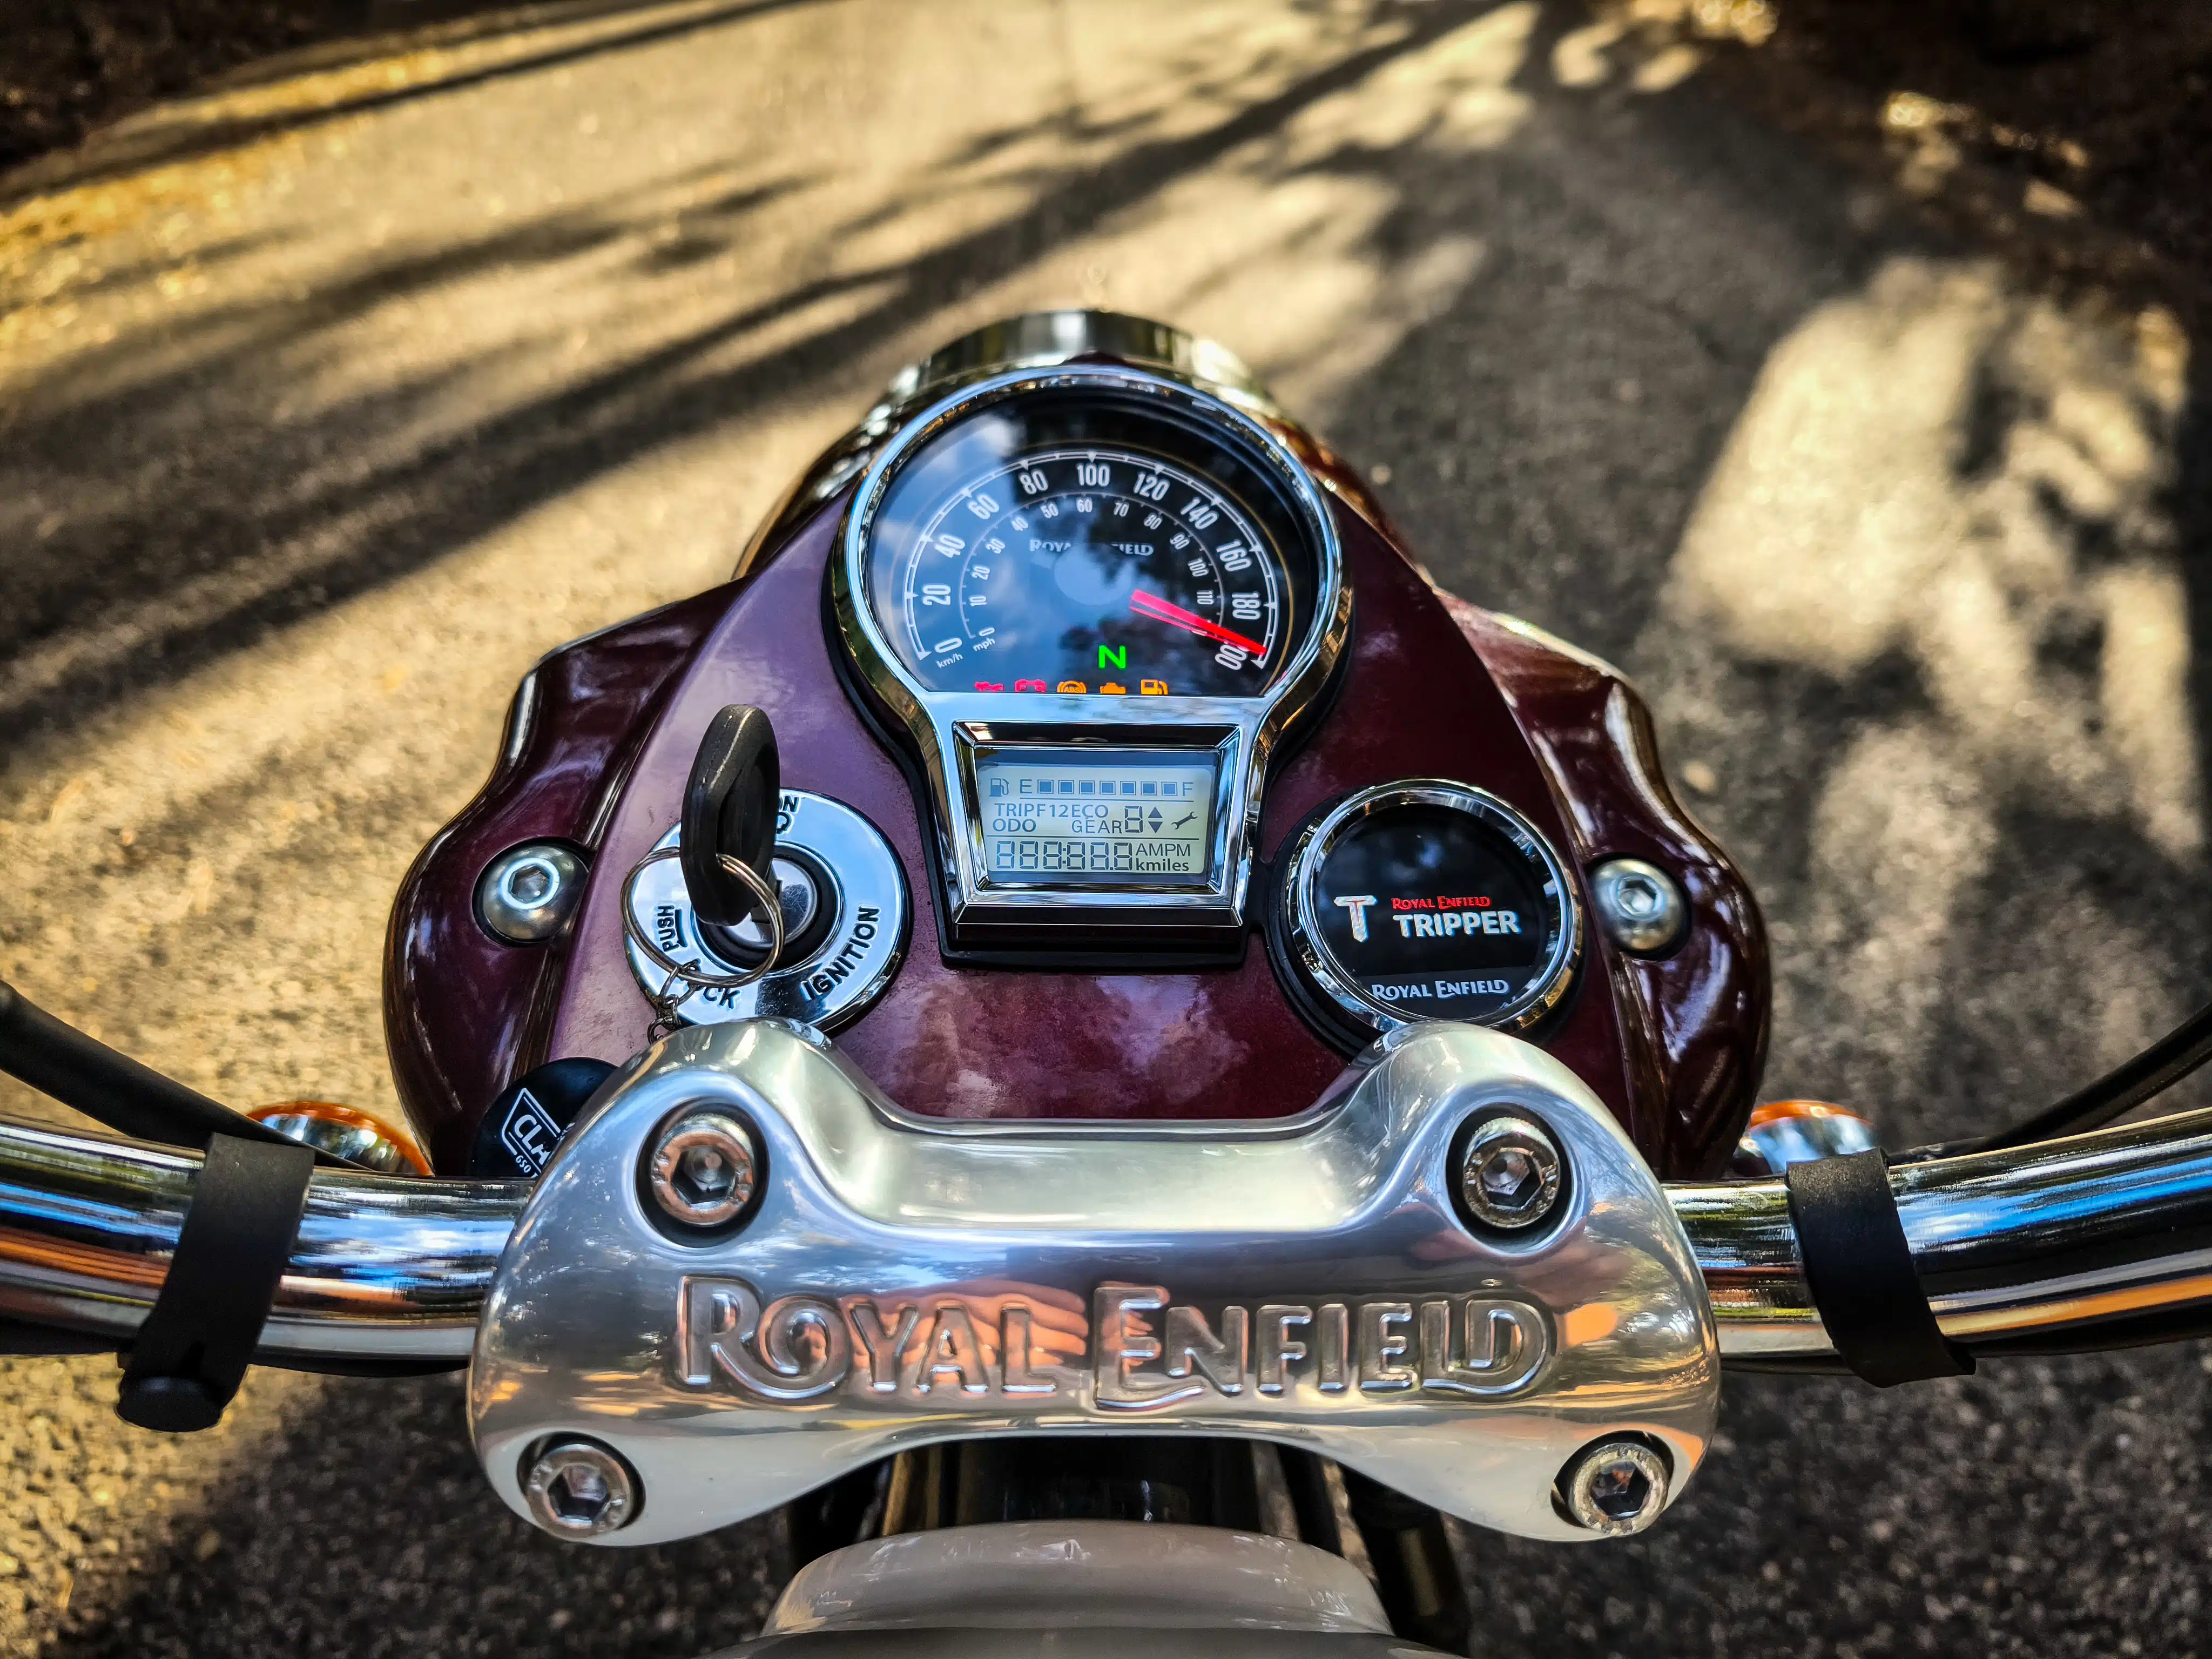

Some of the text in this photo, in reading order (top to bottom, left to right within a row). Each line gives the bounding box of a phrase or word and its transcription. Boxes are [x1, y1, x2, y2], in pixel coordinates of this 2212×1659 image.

[1019, 469, 1048, 495] 80
[1077, 463, 1110, 487] 100
[1134, 473, 1171, 501] 120
[967, 494, 1000, 520] 60
[1040, 502, 1059, 519] 50
[1076, 497, 1093, 513] 60
[1114, 501, 1130, 517] 70
[1180, 496, 1220, 530] 140
[1011, 516, 1029, 532] 40
[1144, 513, 1163, 530] 80
[935, 534, 966, 558] 40
[986, 537, 1006, 554] 30
[1170, 532, 1190, 550] 90
[1216, 538, 1252, 572] 160
[972, 564, 991, 580] 20
[1188, 557, 1210, 578] 100
[923, 584, 951, 605] 20
[970, 595, 987, 606] 10
[1197, 589, 1214, 605] 110
[1231, 592, 1262, 621] 180
[979, 626, 995, 638] 0
[934, 637, 962, 654] 0
[973, 636, 996, 652] mph
[936, 652, 963, 669] km/h
[1098, 644, 1127, 670] N
[1215, 642, 1249, 671] 00
[1020, 779, 1193, 797] E F
[992, 818, 1036, 833] ODO
[1071, 819, 1123, 834] GEAR
[1391, 895, 1492, 911] ROYAL ENFIELD
[656, 905, 675, 952] PUSH
[1393, 911, 1522, 939] TRIPPER
[800, 906, 880, 1000] IGNITION
[1372, 979, 1510, 1001] ROYAL ENFIELD
[676, 1273, 1556, 1411] ROYAL ENFIELD
